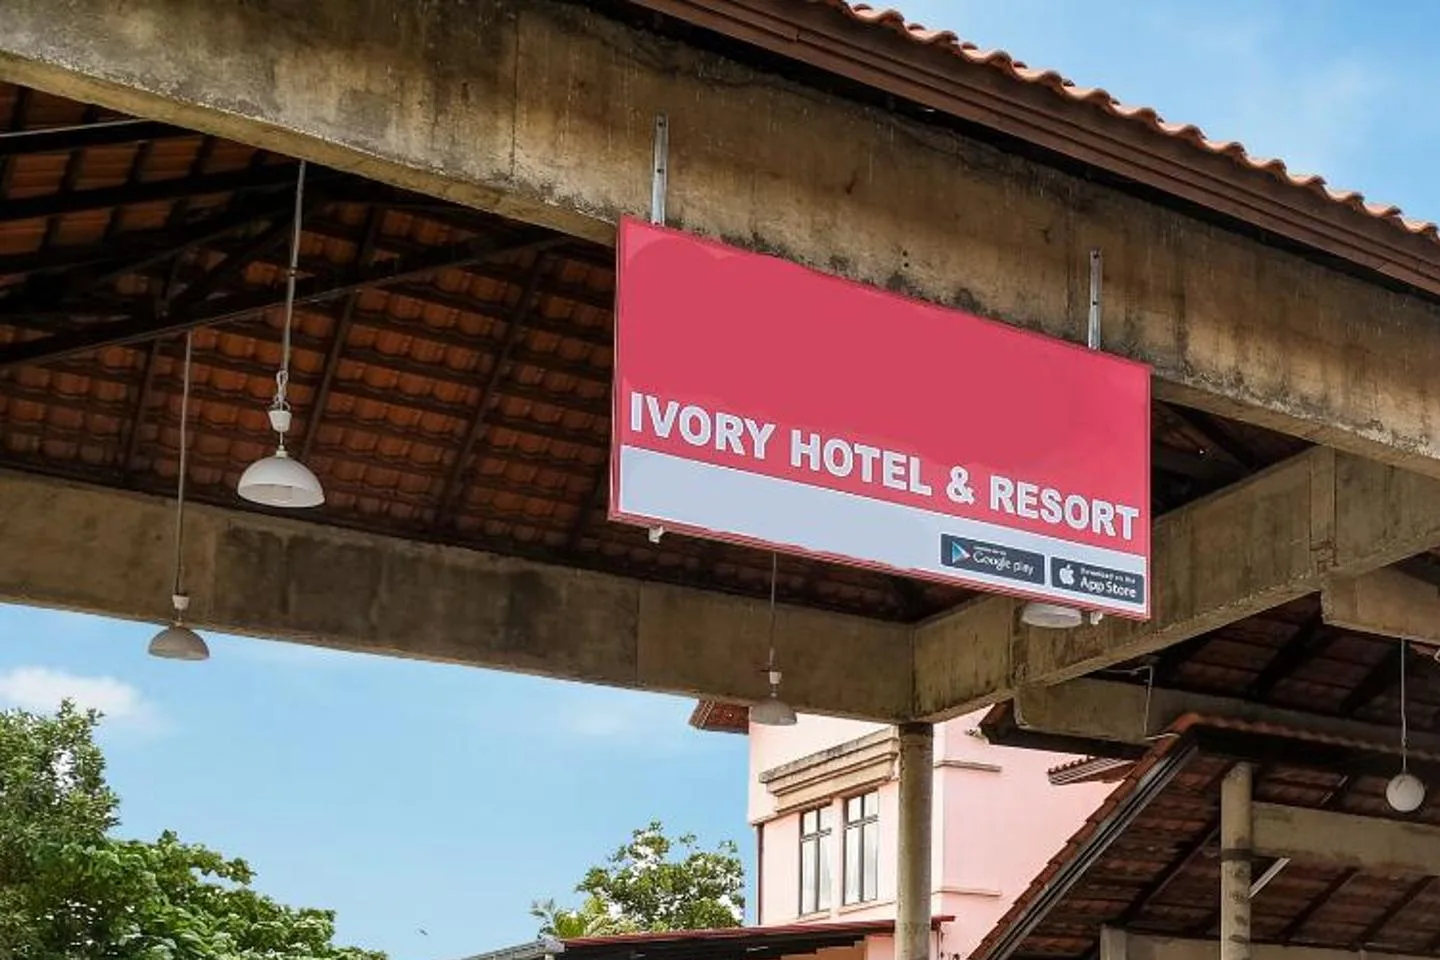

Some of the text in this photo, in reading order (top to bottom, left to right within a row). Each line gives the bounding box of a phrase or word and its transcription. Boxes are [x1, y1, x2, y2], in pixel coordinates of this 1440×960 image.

[631, 391, 1140, 540] IVORY HOTEL & RESORT
[973, 550, 1012, 571] Google
[1080, 576, 1137, 598] App Store
